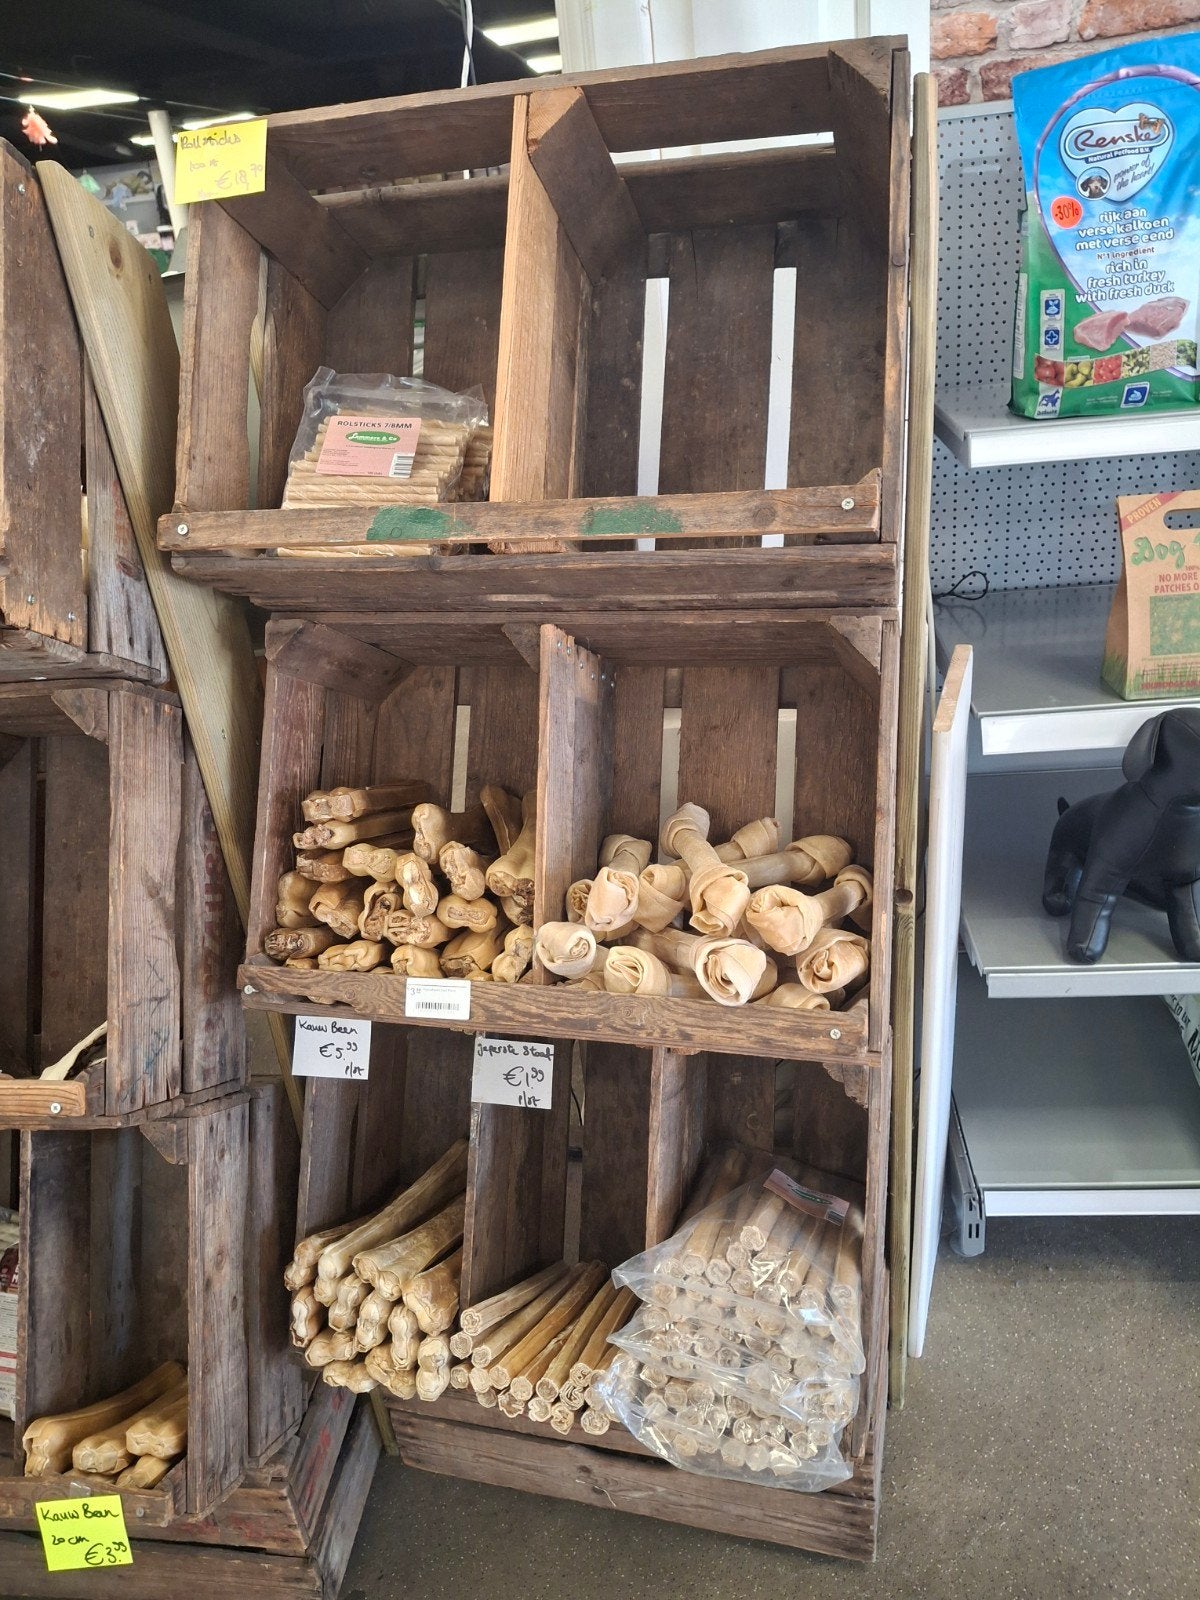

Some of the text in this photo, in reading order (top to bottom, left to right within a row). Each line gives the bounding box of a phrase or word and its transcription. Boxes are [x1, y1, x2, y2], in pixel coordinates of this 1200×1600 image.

[1074, 125, 1161, 151] Renske
[1088, 152, 1113, 163] Natural
[1114, 148, 1139, 156] Petfood
[1055, 201, 1080, 220] -30%
[1099, 208, 1147, 224] rijk aan
[1078, 217, 1169, 238] verse kalkoen
[1076, 229, 1174, 251] met verse eend
[1112, 246, 1155, 259] ingredient
[1105, 258, 1148, 273] rich in
[1087, 270, 1165, 289] fresh turkey
[1075, 281, 1175, 303] with fresh duck
[337, 420, 381, 428] ROLSTICKS
[1126, 497, 1161, 523] PROVEN
[1130, 536, 1186, 569] Dog
[1159, 572, 1198, 582] NO MORE
[1154, 584, 1191, 593] PATCHES
[298, 1019, 358, 1034] Kauw Been
[40, 1507, 80, 1521] Kauw
